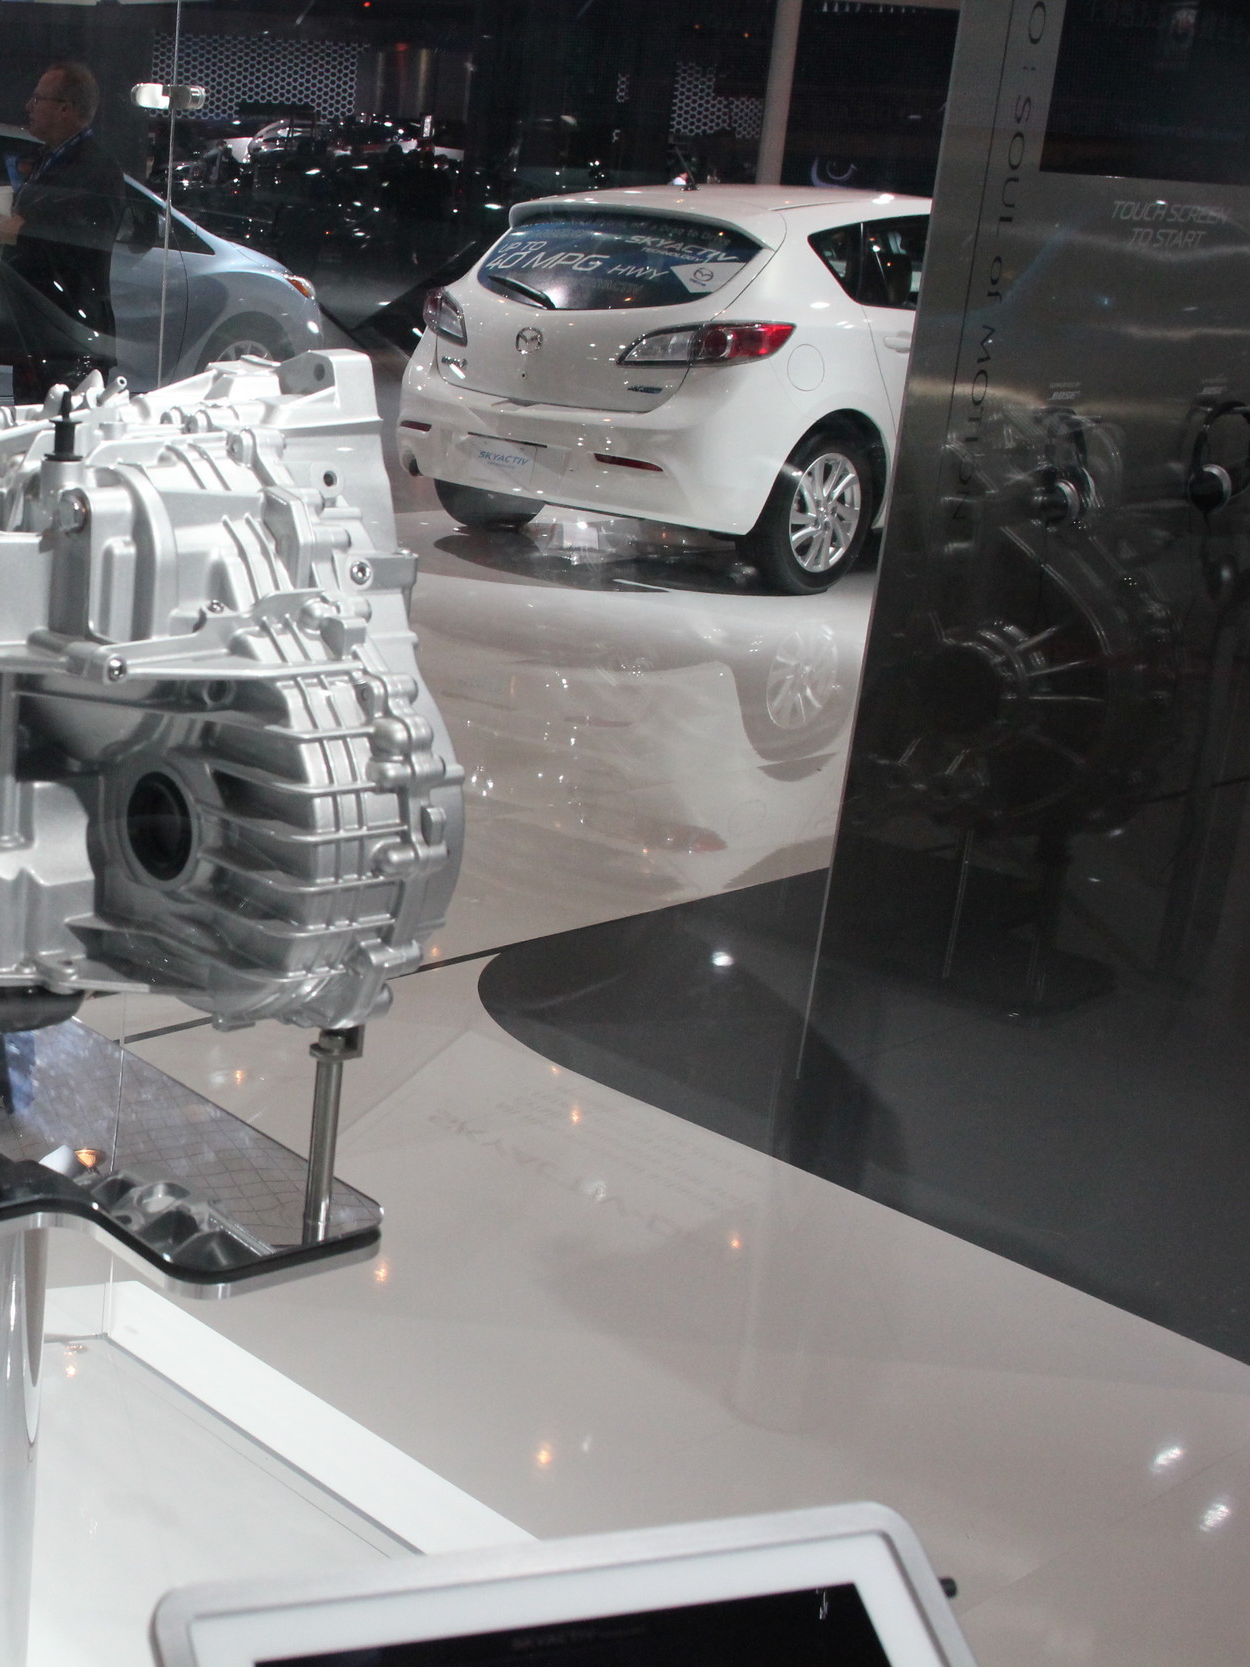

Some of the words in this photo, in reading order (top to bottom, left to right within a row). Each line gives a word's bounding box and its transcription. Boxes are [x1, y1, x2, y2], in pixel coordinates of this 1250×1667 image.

[996, 95, 1032, 238] SOUL
[1111, 199, 1168, 222] TOUCH
[1166, 204, 1231, 225] SCREEN
[497, 241, 523, 254] UP
[521, 240, 548, 251] TO
[624, 235, 739, 264] SKYACTIV
[1125, 227, 1153, 248] TO
[1152, 229, 1208, 249] START
[484, 251, 531, 270] 40
[521, 251, 612, 272] MPG
[607, 263, 672, 281] HWY
[987, 255, 1002, 304] of
[952, 325, 995, 520] MOTION
[478, 450, 530, 466] SKYACTIV
